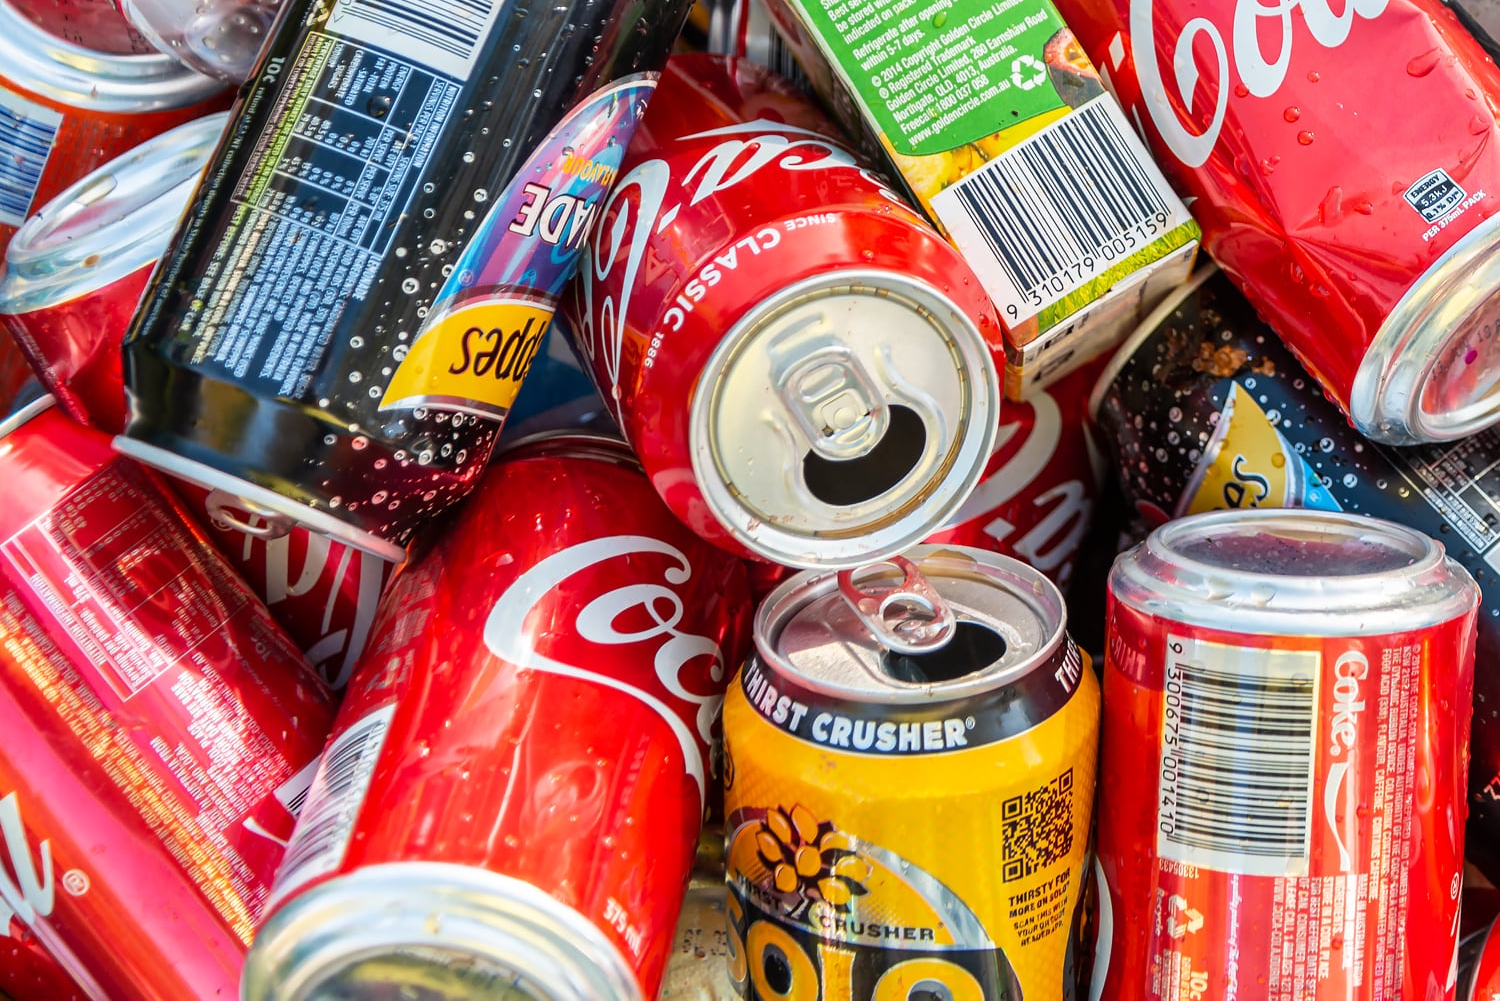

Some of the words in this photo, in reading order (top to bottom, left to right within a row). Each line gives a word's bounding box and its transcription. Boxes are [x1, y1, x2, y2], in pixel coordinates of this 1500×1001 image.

[826, 2, 849, 21] Best
[834, 17, 849, 33] be
[845, 2, 875, 26] stored
[841, 14, 882, 45] indicated
[879, 7, 894, 22] on
[852, 25, 900, 61] Refrigerate
[896, 13, 920, 34] after
[859, 48, 889, 72] within
[885, 39, 904, 57] 5-7
[900, 26, 926, 48] days.
[880, 62, 904, 83] 2014
[900, 38, 943, 71] Copyright
[939, 21, 972, 47] Golden
[967, 7, 995, 30] Circle
[884, 85, 917, 112] Golden
[912, 71, 941, 95] Circle
[936, 51, 973, 80] Limited,
[969, 42, 989, 61] 260
[985, 19, 1027, 51] Earnshaw
[1023, 7, 1048, 28] Road
[377, 60, 397, 89] PROTEIN
[389, 64, 408, 92] ENERGY
[886, 60, 933, 94] Registered
[929, 33, 977, 68] Trademark
[891, 89, 938, 124] Northgate,
[934, 77, 957, 98] QLD,
[953, 63, 980, 87] 4013,
[977, 41, 1018, 72] Australia.
[433, 84, 457, 122] NUTRITION
[899, 105, 937, 134] Freecall:
[933, 93, 957, 114] 1800
[954, 83, 973, 101] 037
[970, 73, 990, 91] 058
[906, 77, 1012, 148] www.goldencircle.com.au
[411, 120, 440, 168] INFORMATION
[1409, 174, 1440, 199] ENERGY
[1420, 182, 1448, 208] 5.3kJ
[784, 211, 838, 232] SINCE
[1421, 224, 1441, 242] PER
[1437, 206, 1465, 229] 375mL
[1462, 189, 1487, 210] PACK
[351, 254, 381, 301] LEMONADE
[663, 227, 782, 333] CLASSIC
[1004, 302, 1021, 321] 9
[1026, 254, 1098, 307] 310179
[1099, 209, 1170, 261] 005159
[644, 332, 666, 368] 1886
[1168, 642, 1184, 655] 9
[744, 656, 809, 733] THIRST
[811, 711, 968, 753] CRUSHER
[1163, 666, 1183, 753] 300675
[1332, 650, 1369, 749] Coke
[1159, 755, 1179, 835] 001410
[596, 895, 632, 933] 375
[1008, 879, 1053, 906] THIRSTY
